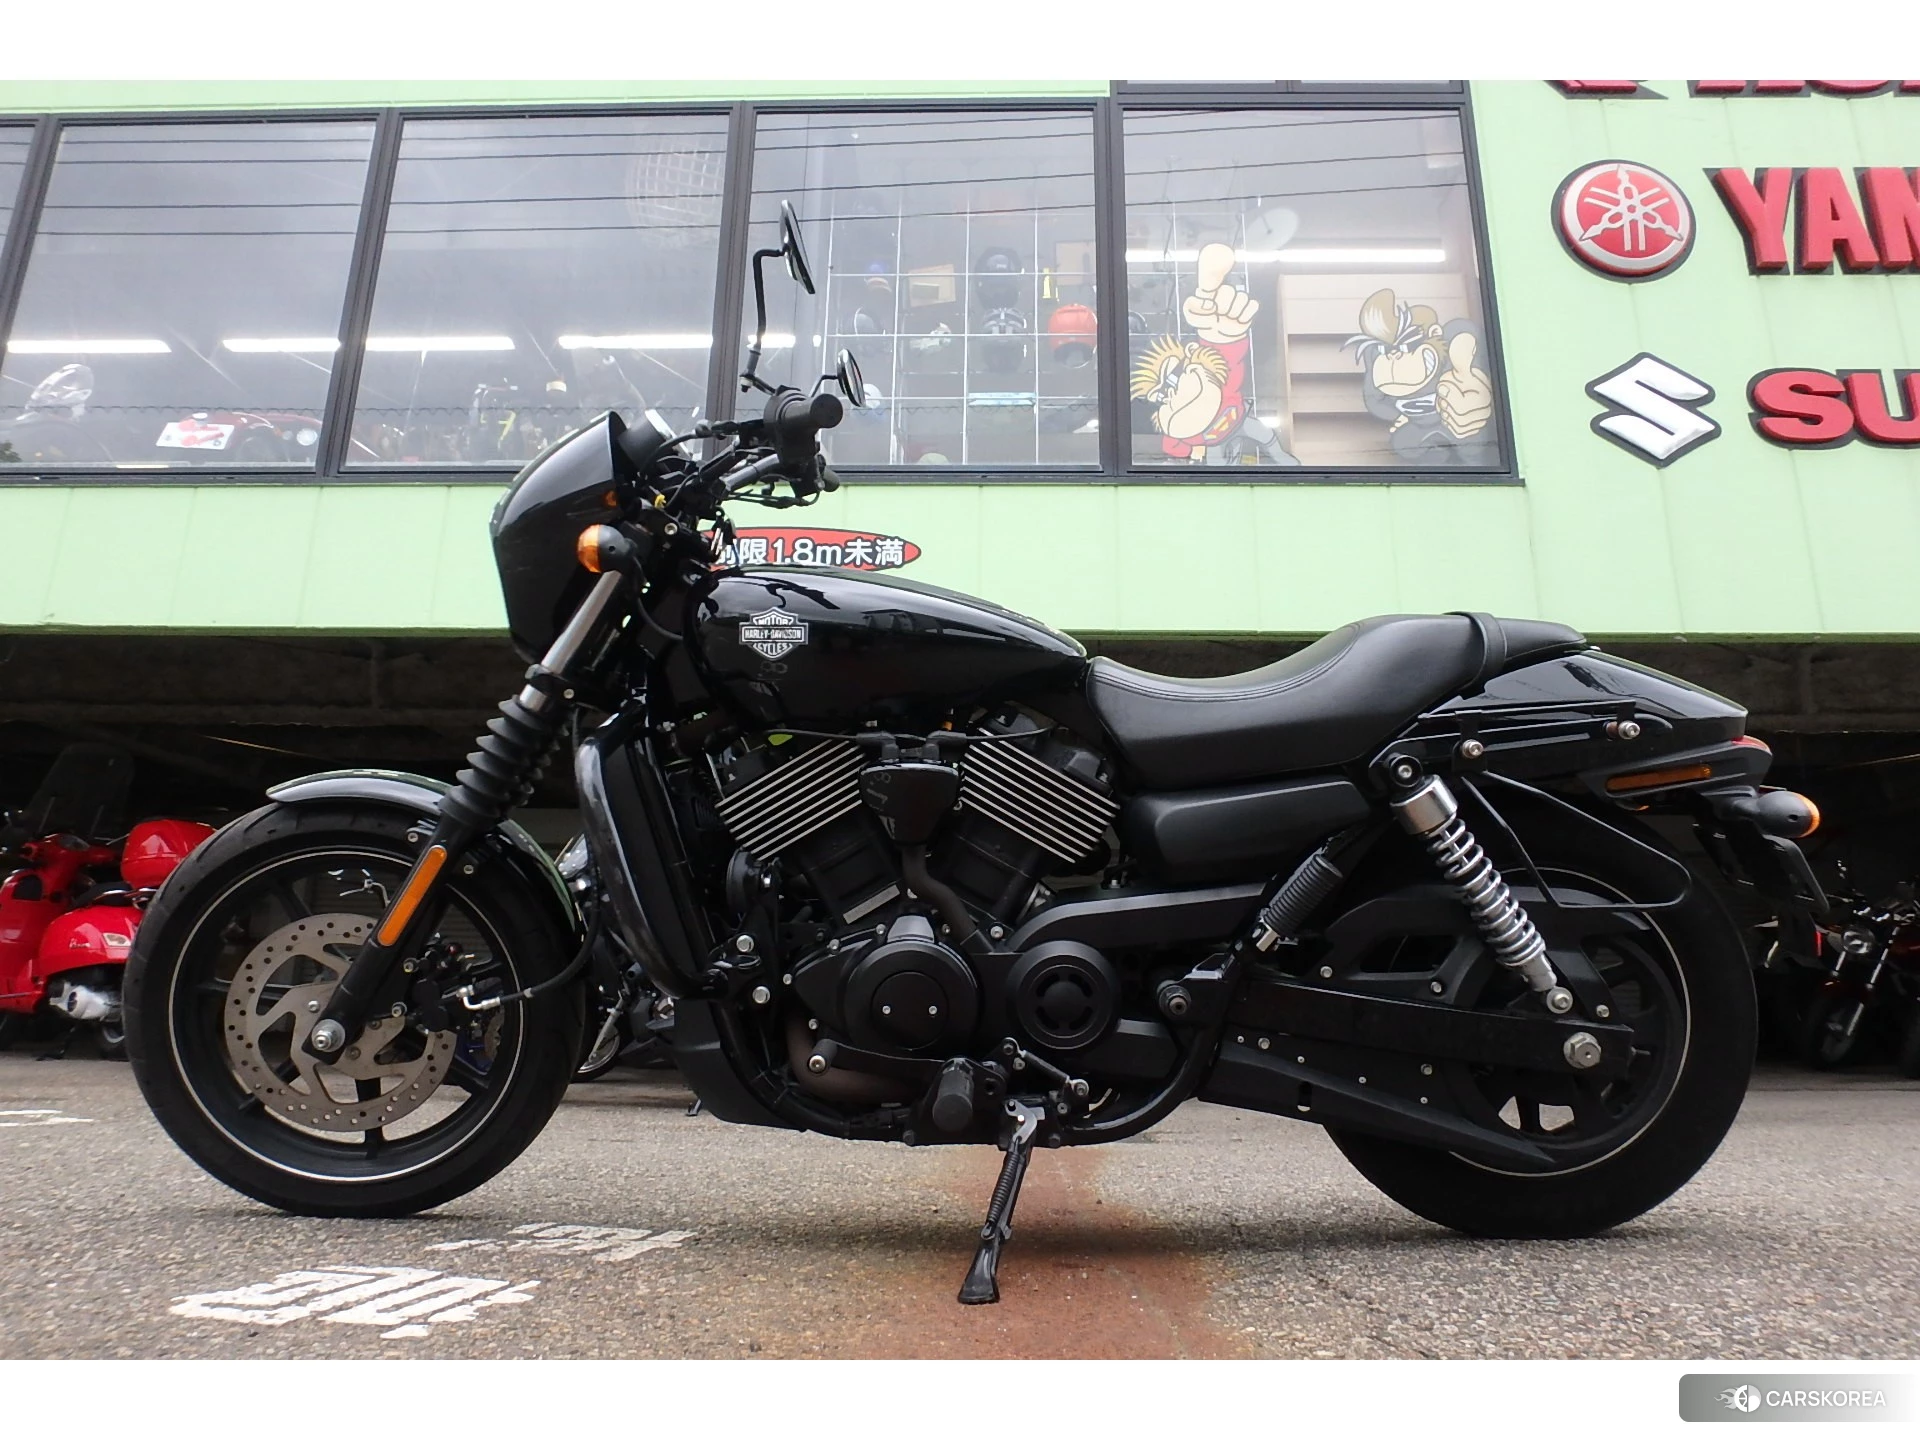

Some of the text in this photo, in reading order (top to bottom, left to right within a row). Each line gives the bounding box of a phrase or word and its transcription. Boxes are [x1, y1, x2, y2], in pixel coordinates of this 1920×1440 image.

[1748, 369, 1920, 448] SU
[757, 614, 789, 626] MOTOR
[744, 628, 801, 639] HARLEY-DAVIDSON
[757, 643, 788, 656] CYCLES
